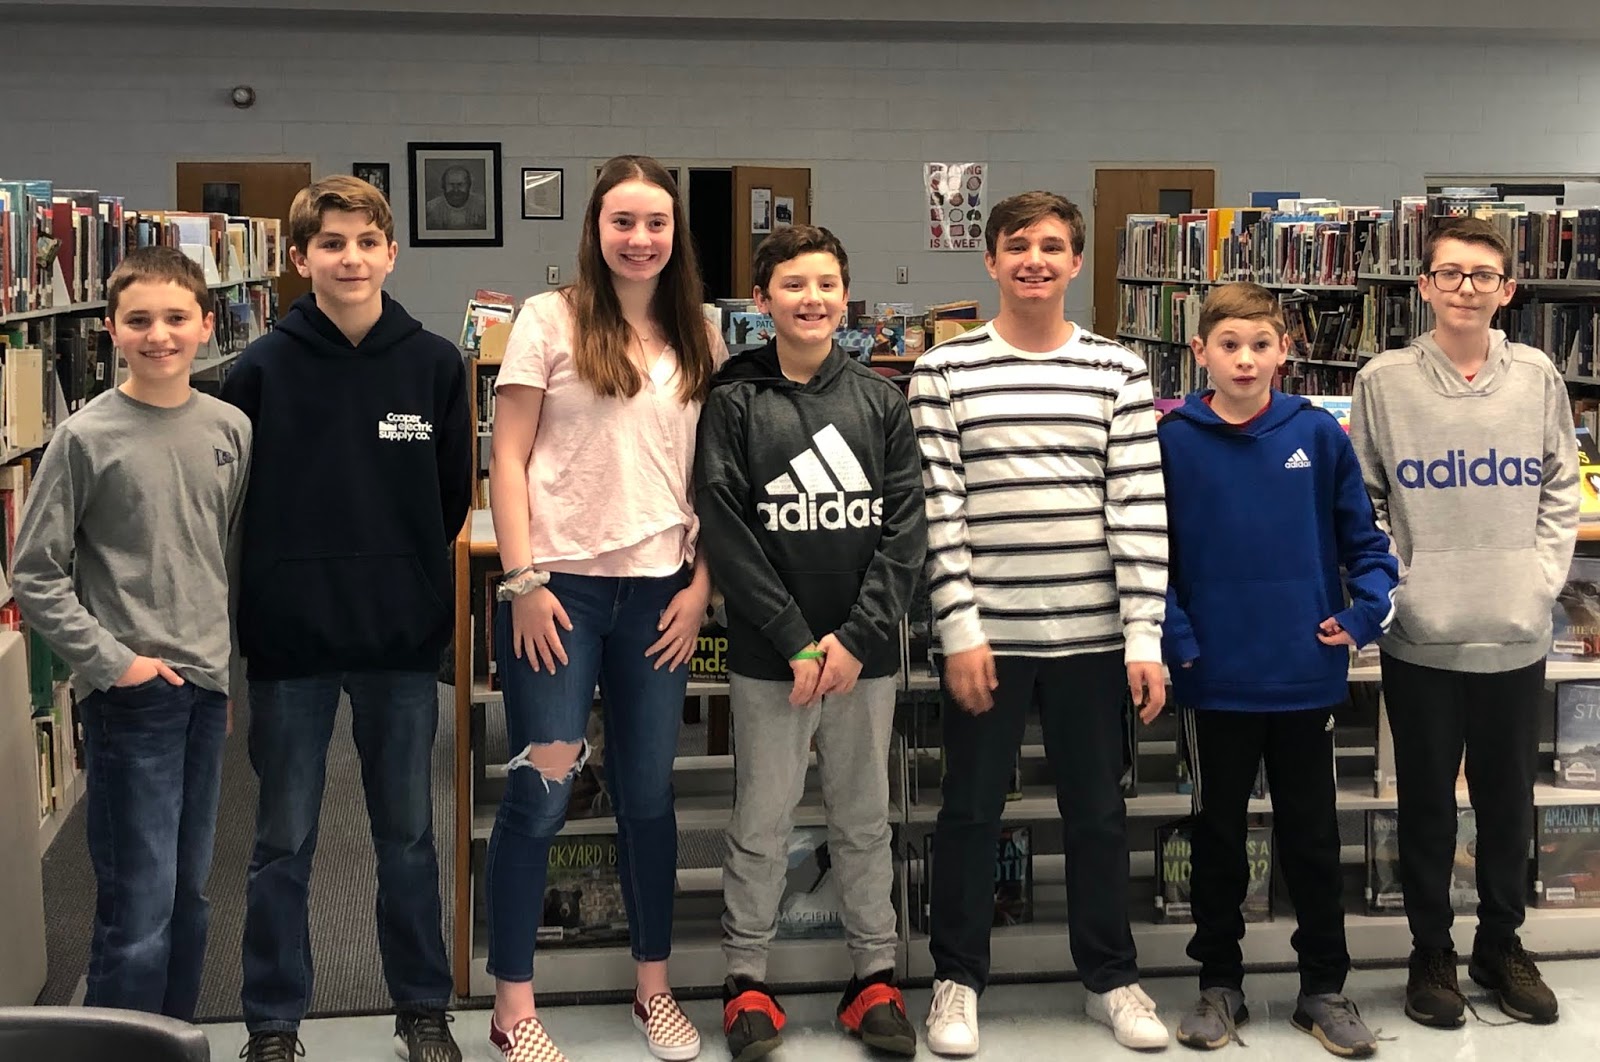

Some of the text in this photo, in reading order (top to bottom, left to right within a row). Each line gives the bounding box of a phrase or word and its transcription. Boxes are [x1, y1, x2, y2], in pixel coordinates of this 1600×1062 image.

[930, 239, 982, 248] IS SWEET
[386, 412, 421, 424] Cooper
[398, 421, 433, 433] electric
[379, 430, 430, 442] supply co.
[1396, 448, 1543, 489] adidas
[756, 491, 883, 532] adidas
[1565, 625, 1586, 635] THE
[1544, 806, 1588, 827] AMAZON
